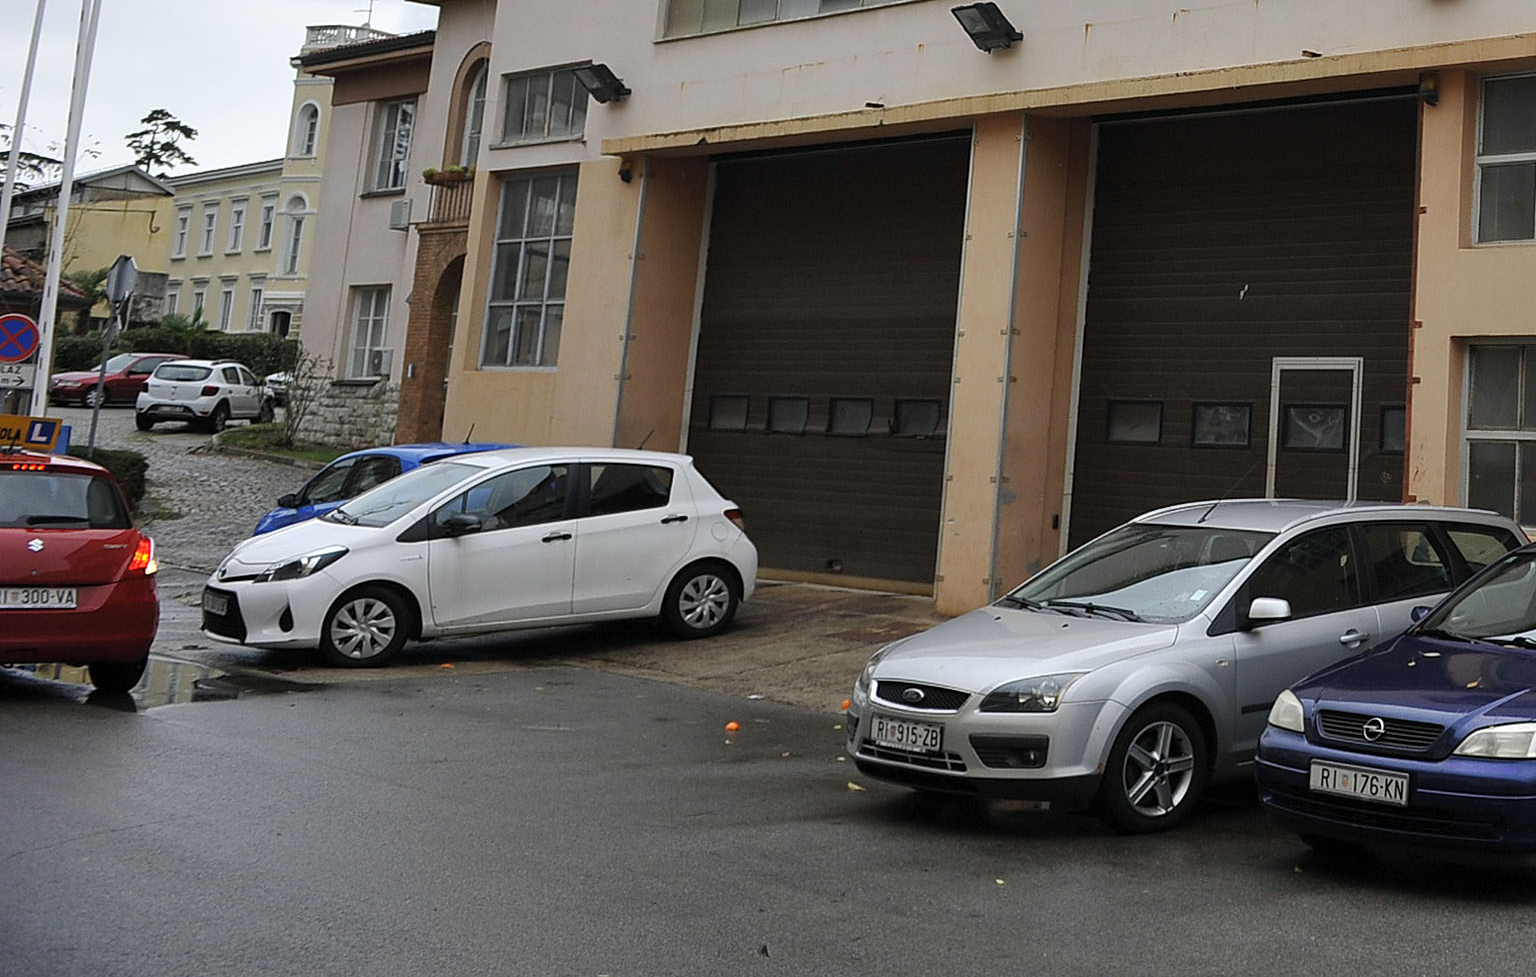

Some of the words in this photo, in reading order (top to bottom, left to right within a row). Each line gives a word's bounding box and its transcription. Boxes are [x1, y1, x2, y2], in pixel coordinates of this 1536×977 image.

[0, 427, 21, 440] OLA
[21, 589, 75, 605] 300-VA
[897, 724, 939, 748] 915-ZB
[1320, 768, 1337, 789] RI
[1353, 773, 1405, 801] 176-KN
